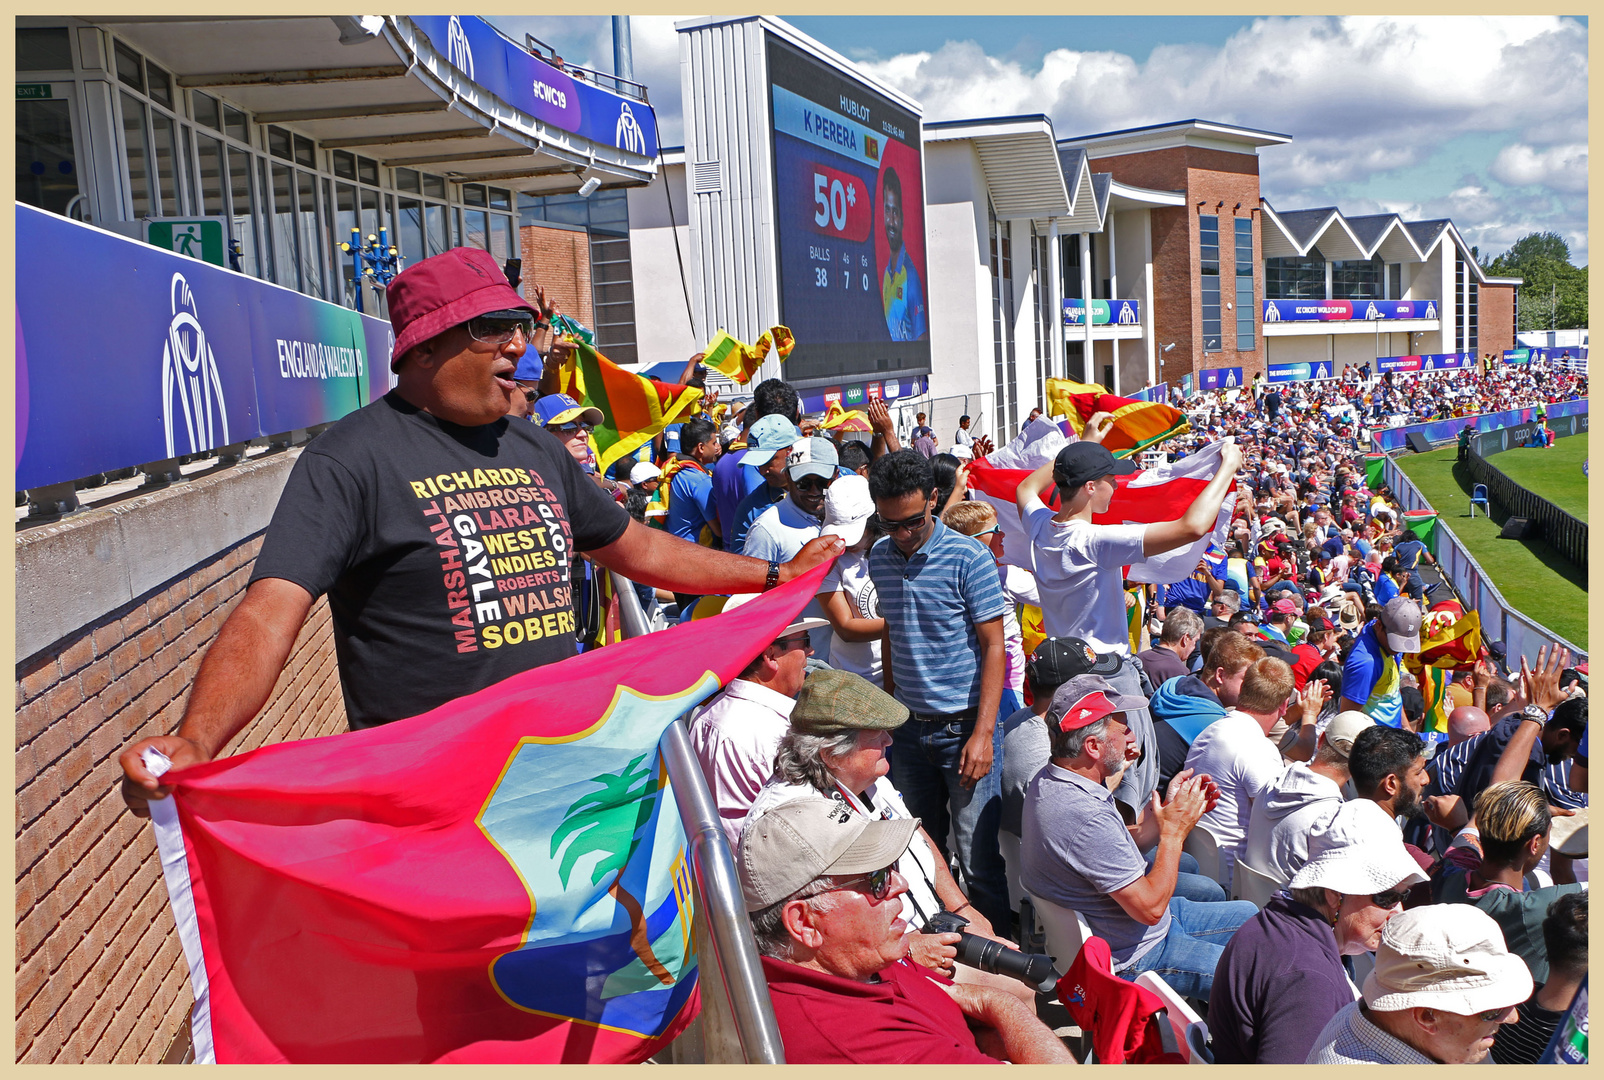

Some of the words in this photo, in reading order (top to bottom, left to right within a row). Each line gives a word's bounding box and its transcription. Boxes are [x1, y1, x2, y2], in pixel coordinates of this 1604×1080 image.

[17, 87, 36, 96] EXIT
[533, 79, 566, 109] #CWC19
[839, 94, 870, 122] HUBLOT
[803, 108, 813, 134] K
[815, 114, 857, 151] PERERA
[809, 245, 831, 262] BALLS
[842, 252, 850, 264] 4s
[861, 255, 868, 267] 6s
[815, 267, 828, 288] 38
[844, 271, 850, 289] 7
[862, 273, 869, 291] 0
[276, 338, 319, 379] ENGLAND
[319, 342, 328, 380] &
[324, 345, 348, 378] WALES
[825, 392, 841, 402] NISSAN
[848, 387, 862, 399] oppo
[1514, 427, 1530, 443] oppo
[409, 467, 532, 499] RICHARDS
[444, 486, 545, 514] AMBROSE
[473, 505, 541, 531] LARA
[481, 526, 547, 555] WEST
[537, 503, 569, 582] LLOYD
[423, 500, 478, 654] MARSHALL
[453, 514, 502, 624] GAYLE
[490, 550, 557, 576] INDIES
[496, 570, 561, 593] ROBERTS
[502, 586, 572, 617] WALSH
[481, 610, 576, 649] SOBERS
